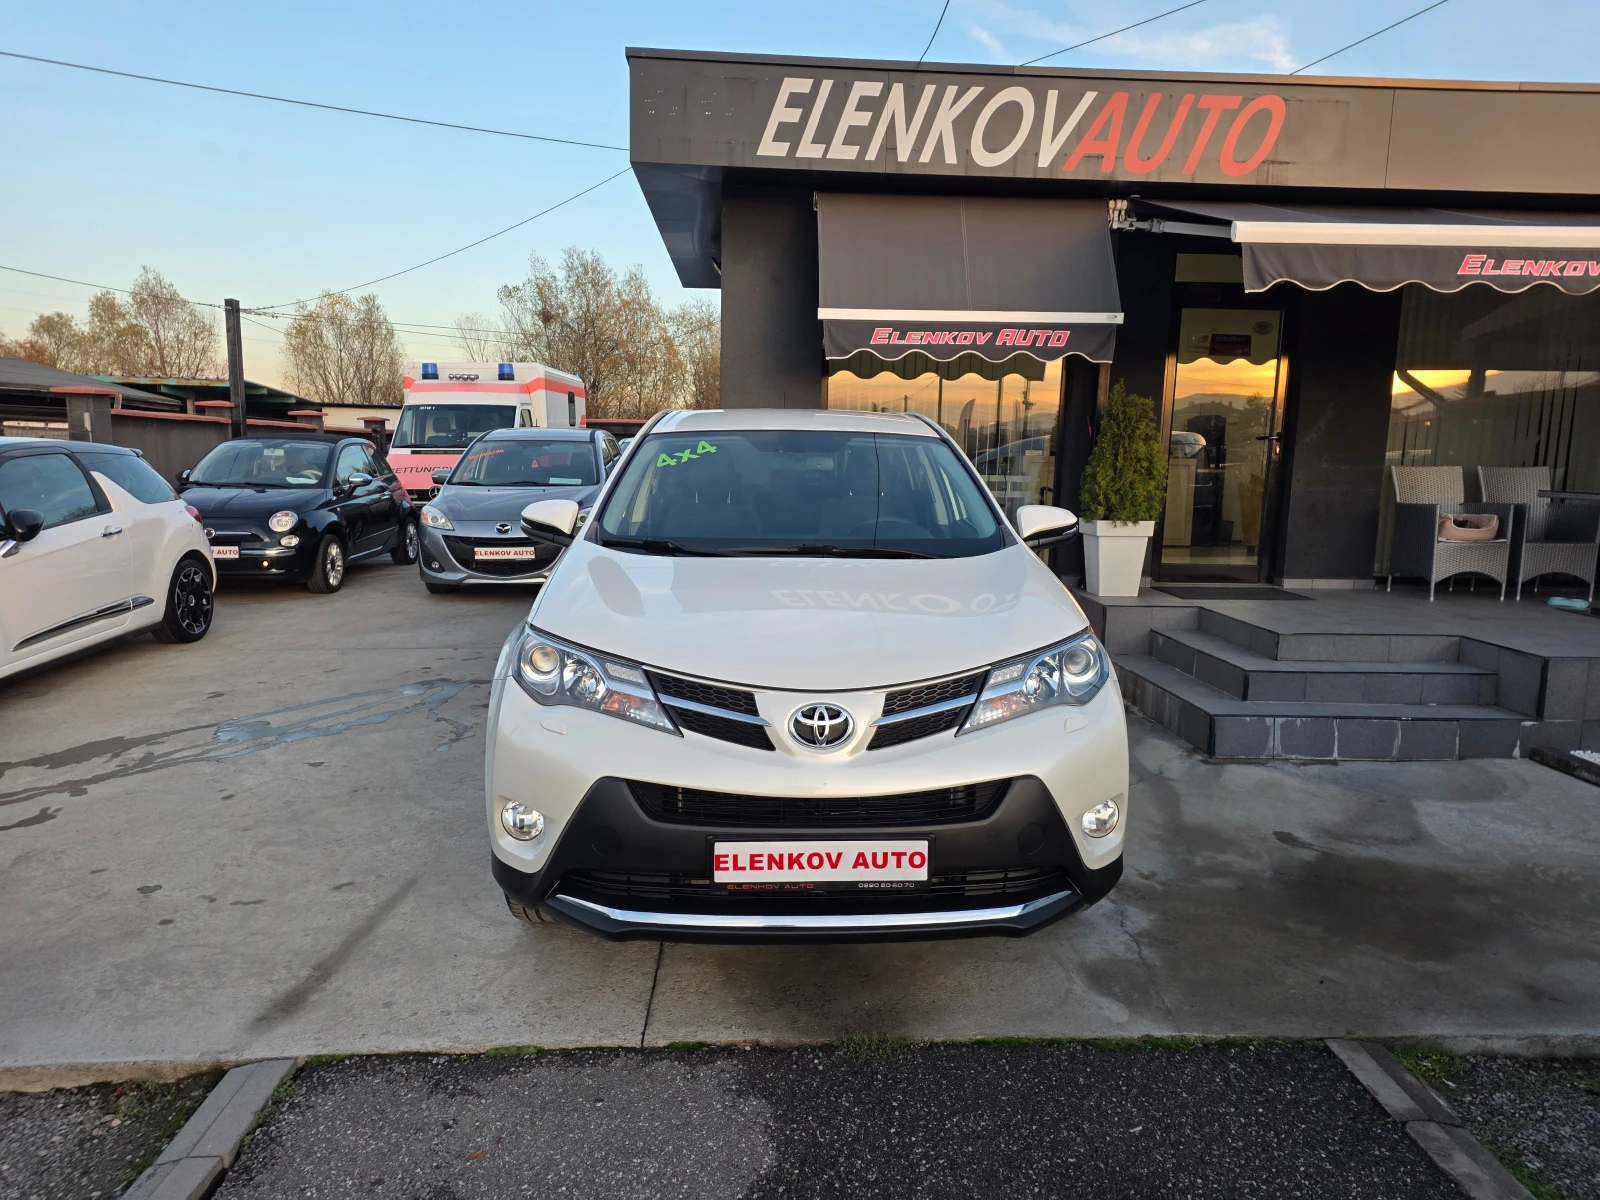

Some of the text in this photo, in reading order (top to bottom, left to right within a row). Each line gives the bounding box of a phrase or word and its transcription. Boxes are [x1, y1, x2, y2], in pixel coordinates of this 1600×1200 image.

[870, 327, 1070, 347] ELENKOV AUTO
[714, 851, 926, 871] ELENKOV AUTO
